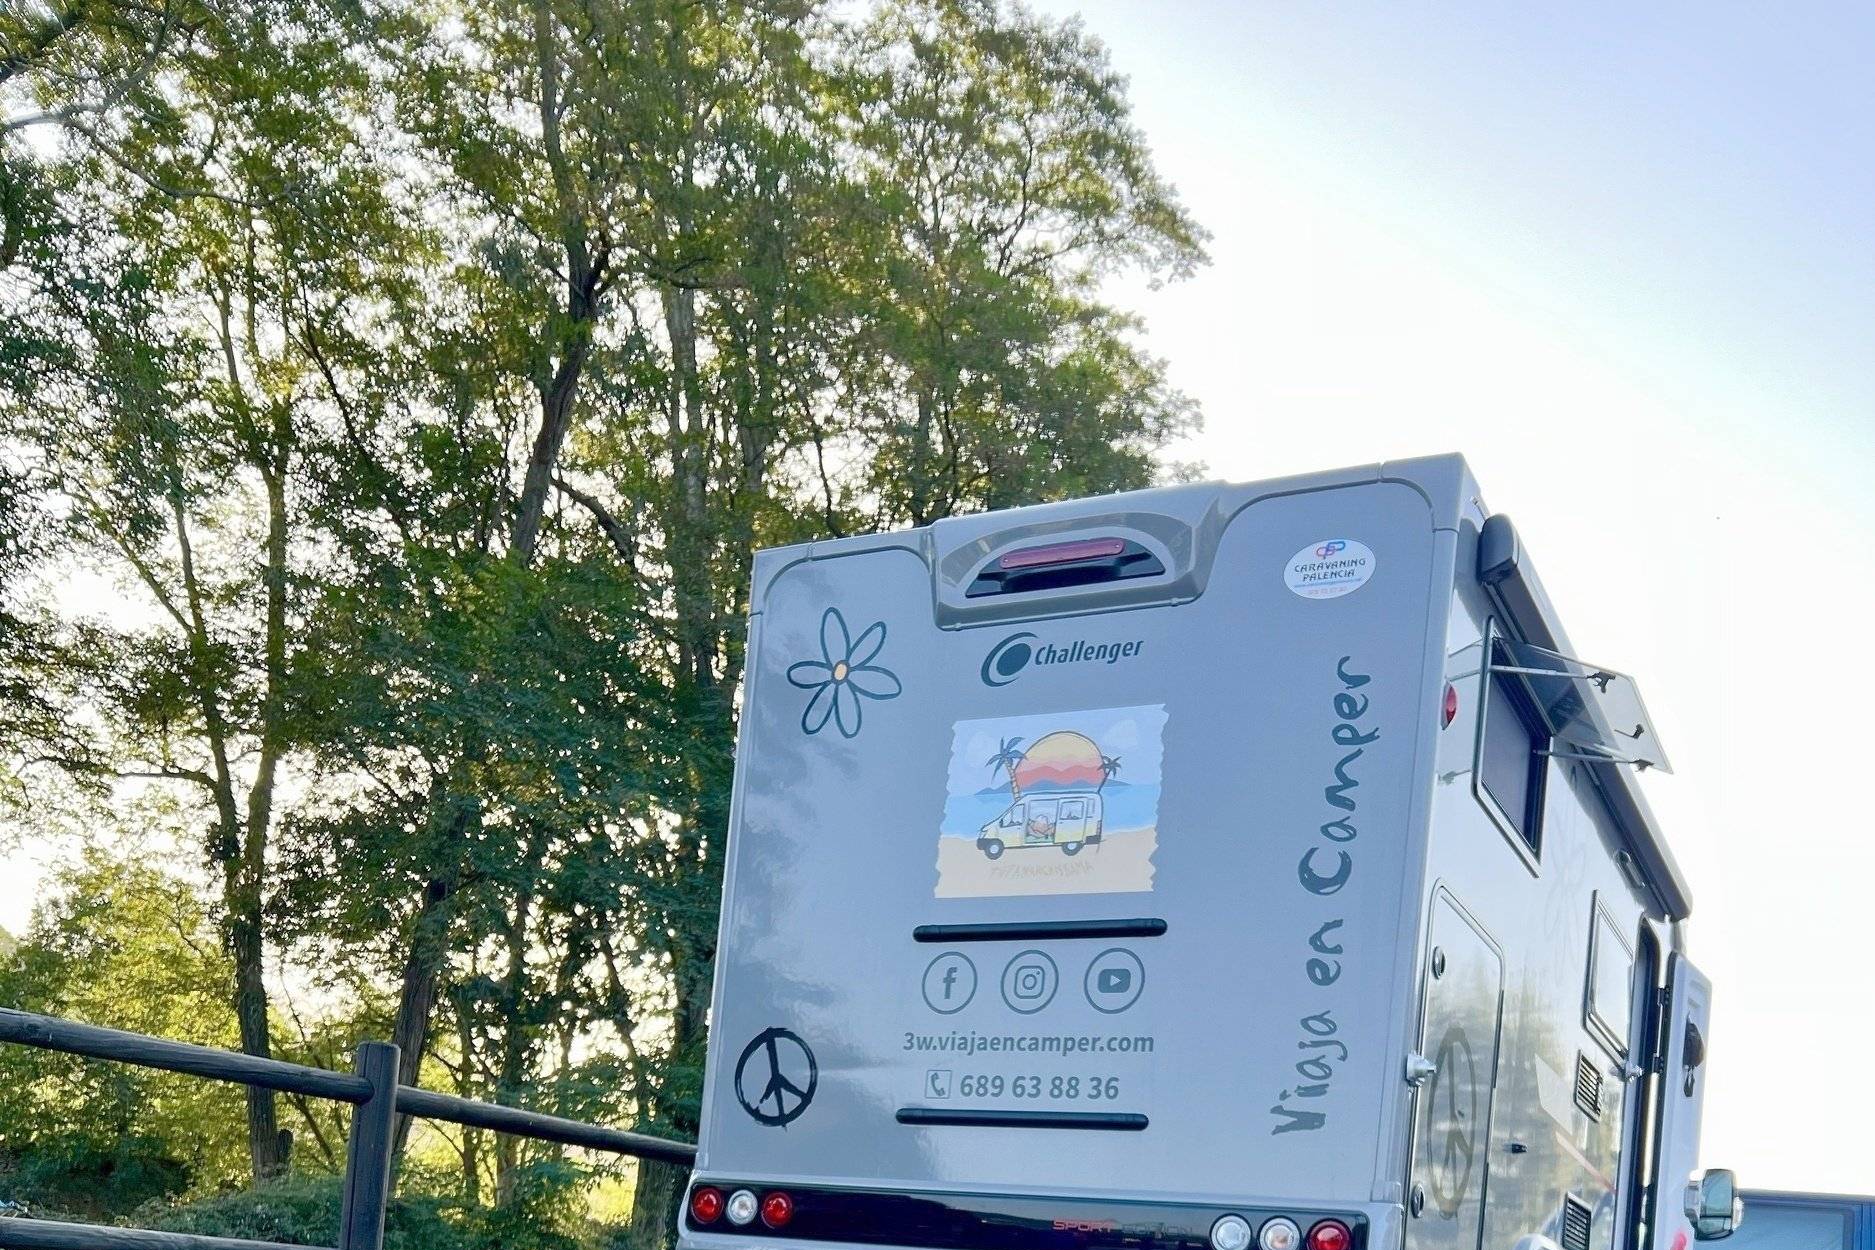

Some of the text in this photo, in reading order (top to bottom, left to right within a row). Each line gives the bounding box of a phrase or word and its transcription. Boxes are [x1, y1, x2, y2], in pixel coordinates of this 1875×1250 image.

[1294, 558, 1366, 573] CARAVANING
[1303, 569, 1356, 582] PALENCIA
[1035, 640, 1144, 665] Challenger
[1298, 656, 1380, 895] Camper
[1306, 919, 1344, 986] en
[903, 1031, 1155, 1057] 3w.viajaencamper.com
[1270, 1010, 1348, 1136] Viaja
[960, 1075, 1120, 1100] 689 63 88 36
[1053, 1219, 1115, 1233] SPORT
